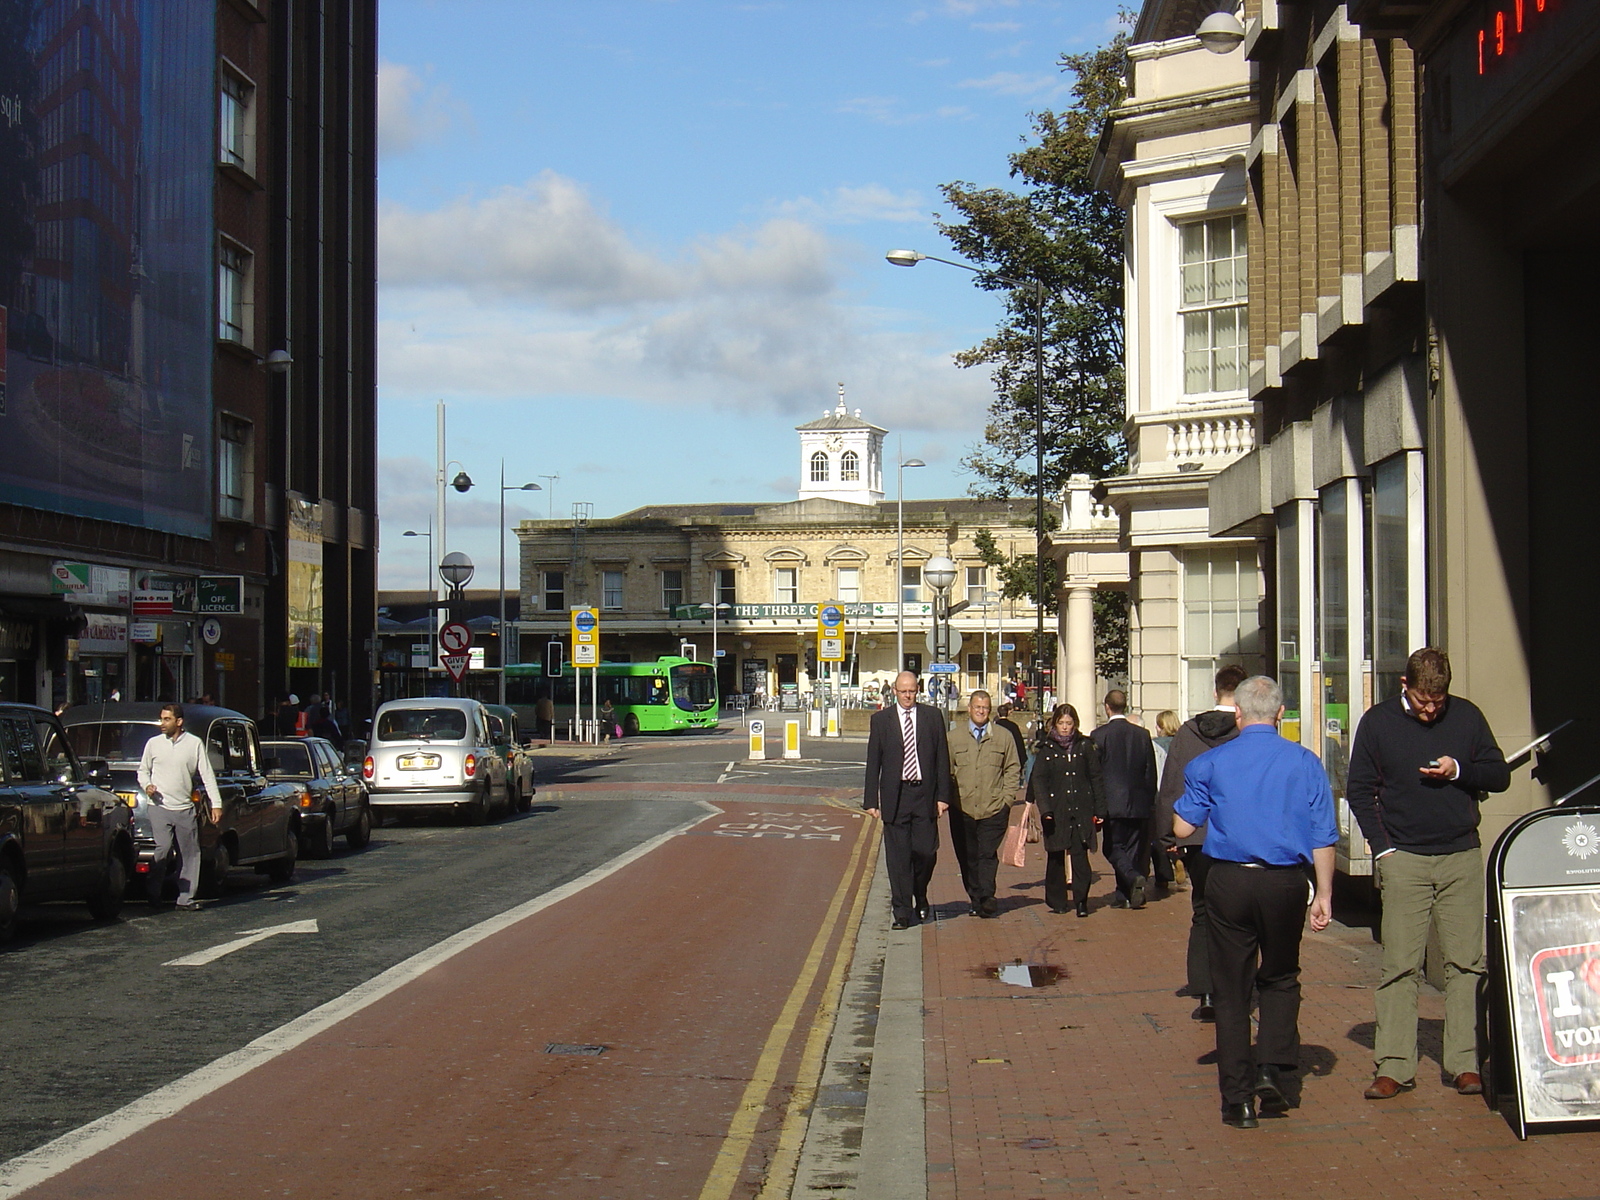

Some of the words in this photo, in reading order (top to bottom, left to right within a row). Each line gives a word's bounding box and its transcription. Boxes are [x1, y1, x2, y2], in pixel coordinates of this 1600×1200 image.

[210, 595, 227, 603] OFF
[200, 604, 236, 612] LICENCE
[734, 605, 760, 616] THE
[763, 605, 807, 616] THREE
[809, 604, 868, 615] GEAS
[719, 822, 845, 832] AND
[713, 829, 842, 842] BUS
[1546, 970, 1582, 1018] I
